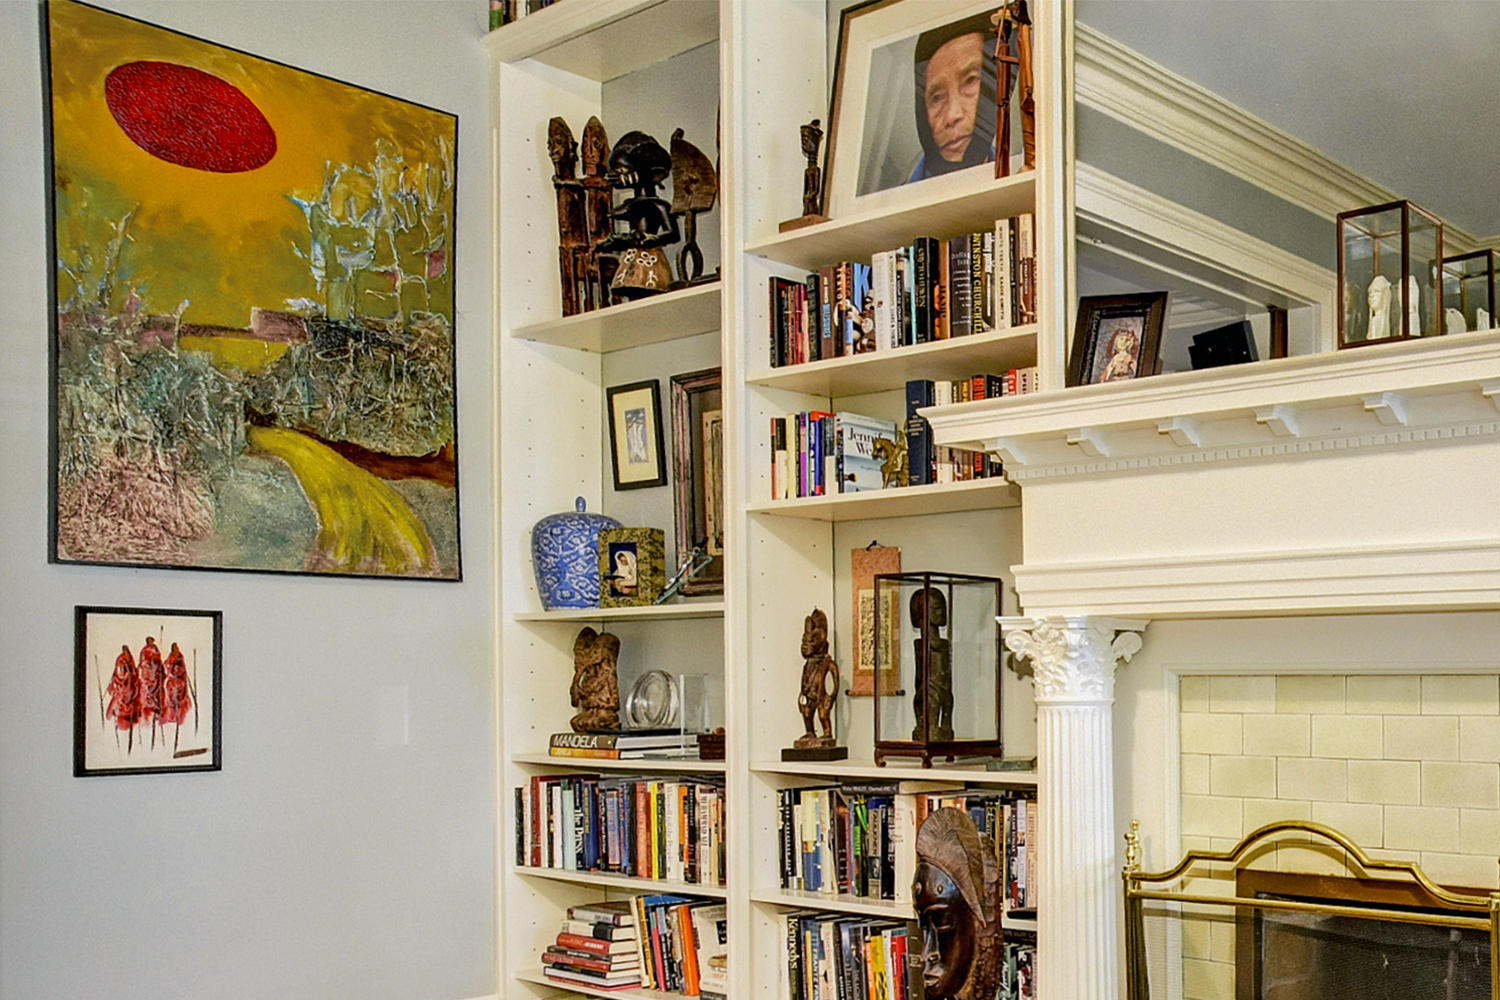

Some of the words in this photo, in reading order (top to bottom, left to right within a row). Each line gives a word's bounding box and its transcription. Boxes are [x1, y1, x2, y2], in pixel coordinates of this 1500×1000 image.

[972, 233, 982, 277] WINSTON
[973, 280, 982, 334] CHURCHILL
[553, 735, 598, 748] MANDELA
